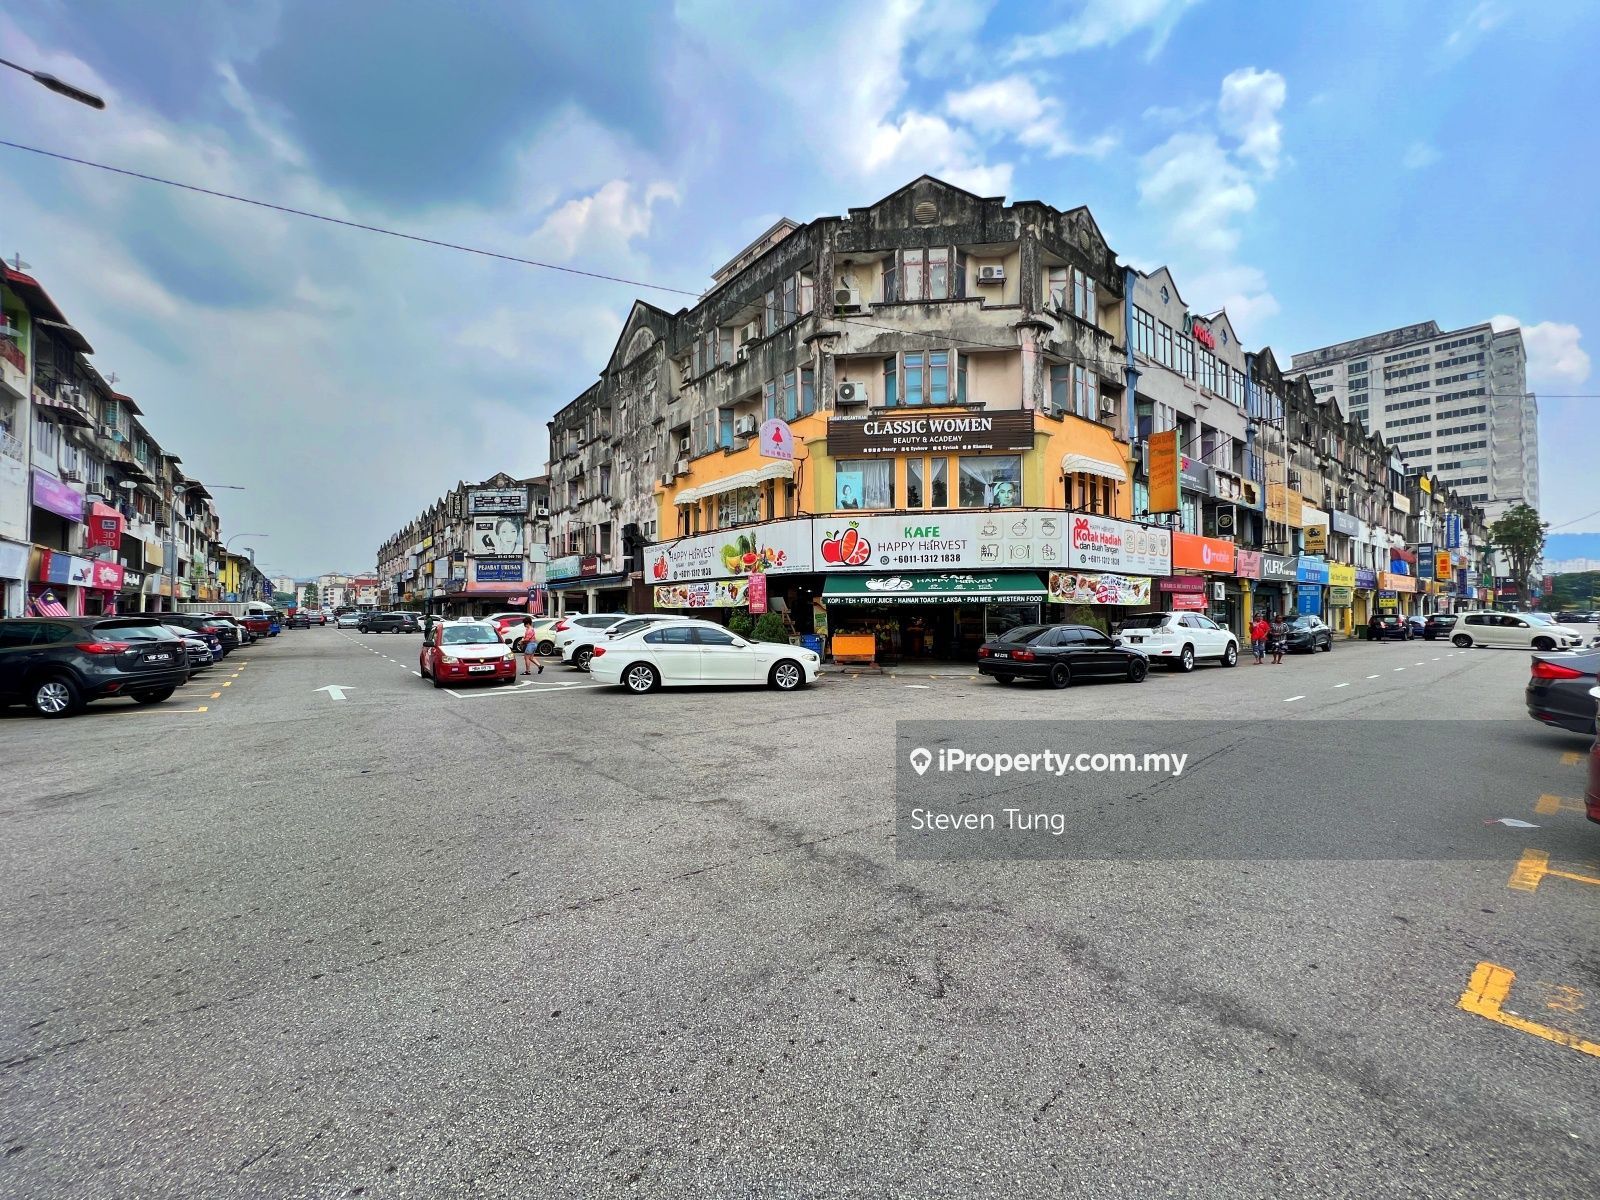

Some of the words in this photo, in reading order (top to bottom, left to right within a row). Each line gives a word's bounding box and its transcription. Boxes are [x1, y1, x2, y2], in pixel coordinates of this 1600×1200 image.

[863, 420, 926, 435] CLASSIC
[929, 417, 993, 432] WOMEN
[904, 526, 940, 538] KAFE
[1100, 534, 1122, 547] Hadiah
[877, 541, 915, 552] HAPPY
[1091, 543, 1104, 552] Buah
[1104, 545, 1120, 554] Tangan
[670, 551, 688, 562] HAPPY
[893, 553, 938, 564] +6011-1312
[940, 553, 961, 563] 1838
